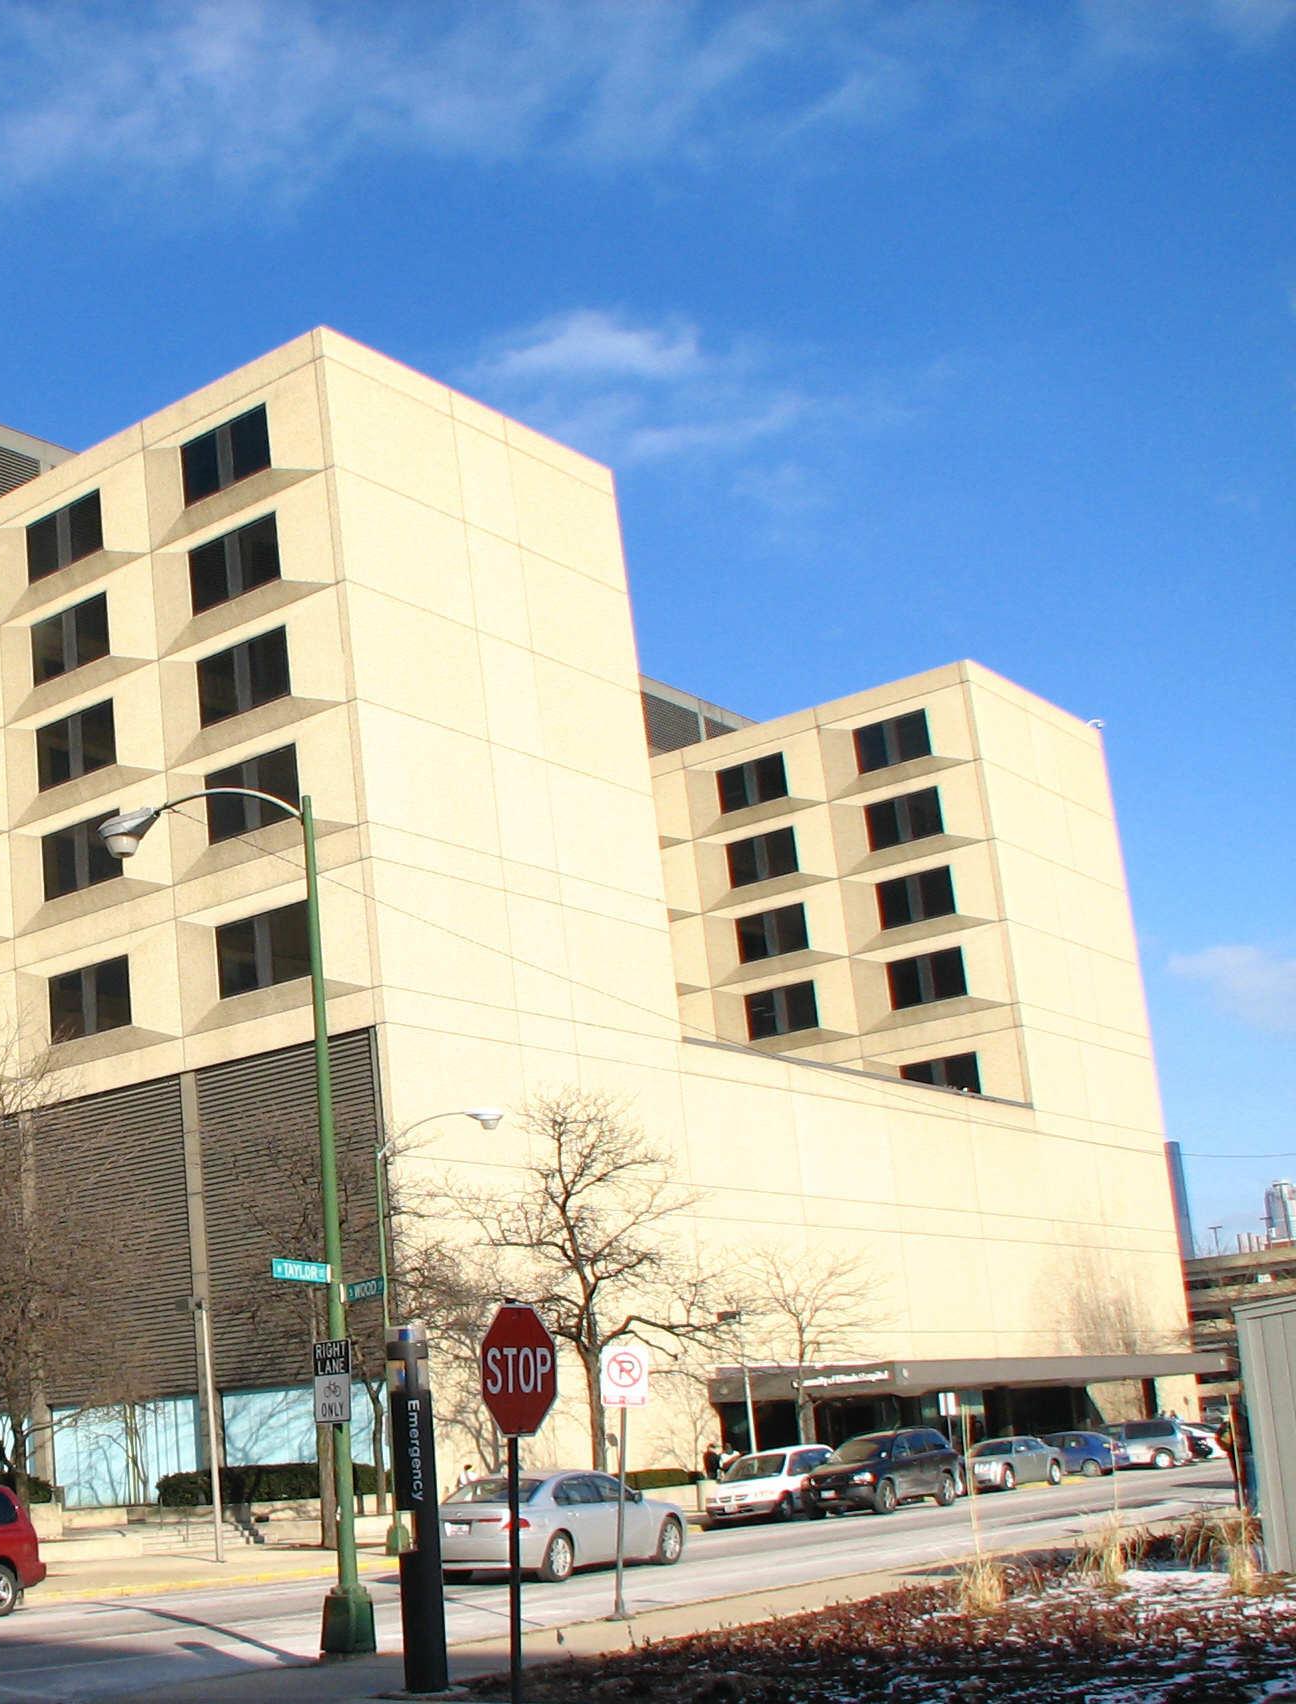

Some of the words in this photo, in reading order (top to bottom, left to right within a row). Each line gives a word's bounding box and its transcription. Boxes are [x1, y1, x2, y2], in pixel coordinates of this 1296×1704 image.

[284, 1263, 318, 1279] TAYLOR
[354, 1281, 377, 1297] WOOD
[315, 1341, 347, 1359] RIGHT
[317, 1358, 345, 1375] LANE
[486, 1347, 552, 1394] STOP
[321, 1402, 343, 1417] ONLY
[408, 1399, 425, 1501] Emergency
